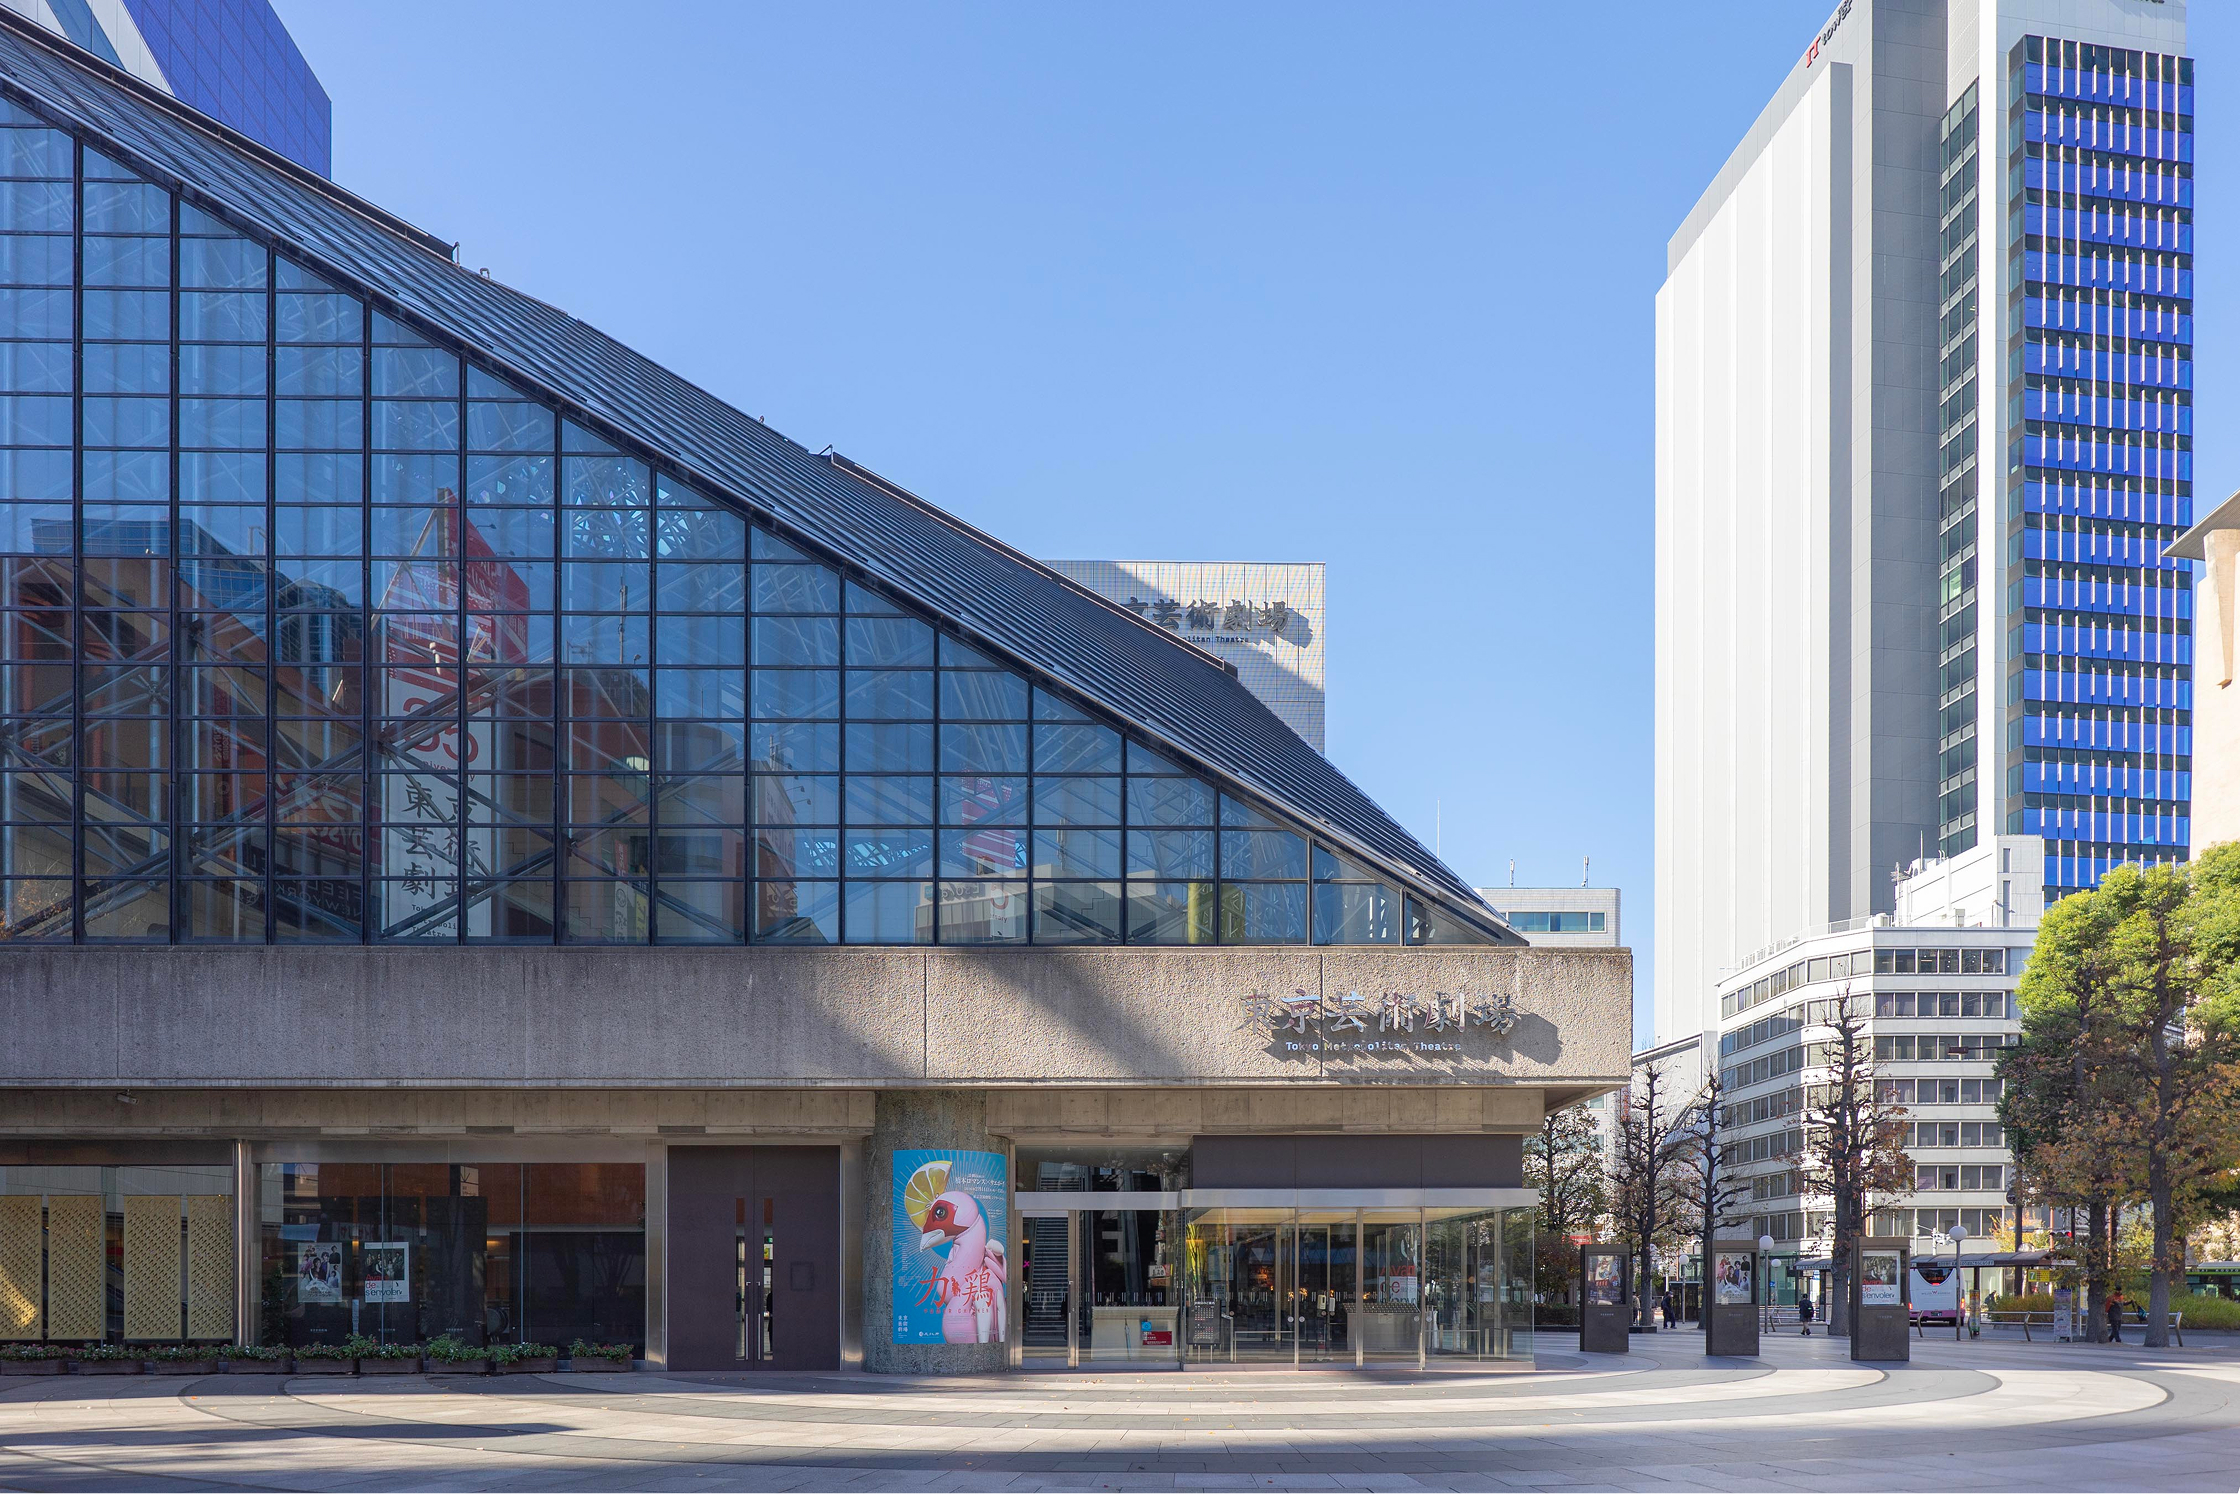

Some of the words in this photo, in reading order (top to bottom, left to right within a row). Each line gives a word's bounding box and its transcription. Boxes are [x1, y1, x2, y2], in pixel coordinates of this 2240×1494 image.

[1806, 36, 1821, 68] IT
[1215, 635, 1249, 643] Theatre
[1236, 988, 1518, 1036] 東京芸術劇場
[1324, 1041, 1409, 1052] Metoolitan
[1413, 1041, 1461, 1051] Theatre
[2030, 1272, 2035, 1280] 7
